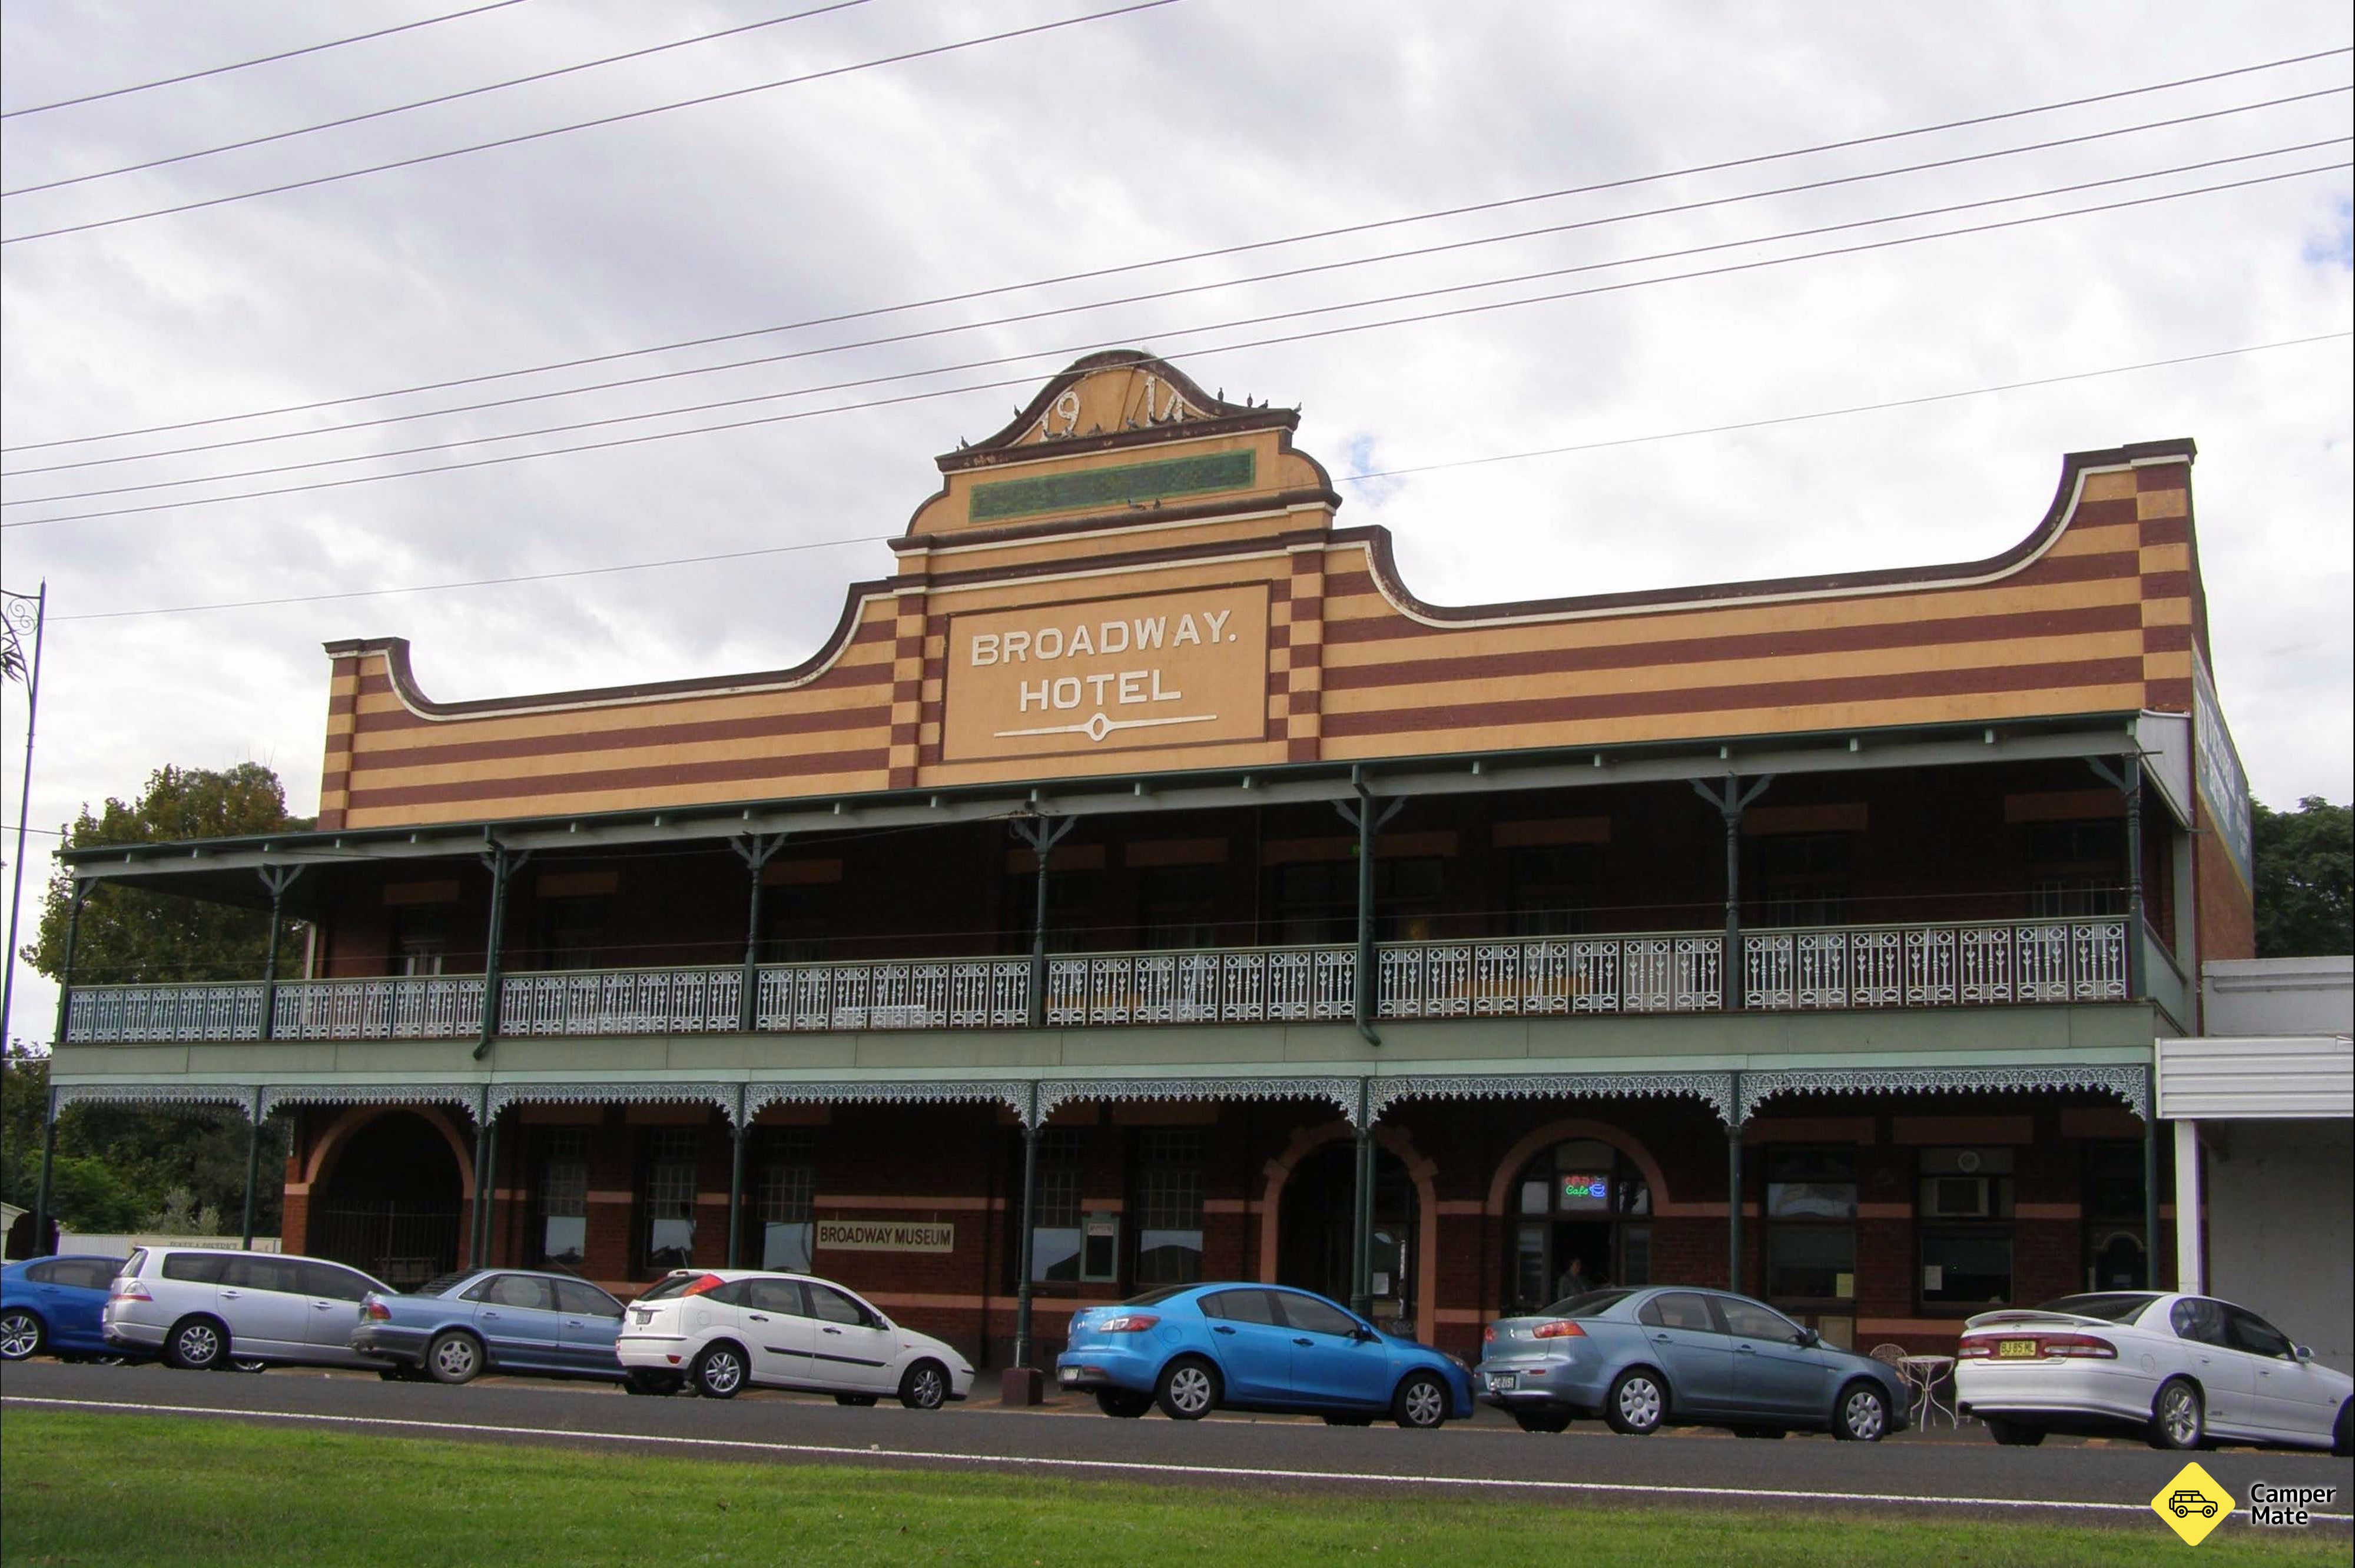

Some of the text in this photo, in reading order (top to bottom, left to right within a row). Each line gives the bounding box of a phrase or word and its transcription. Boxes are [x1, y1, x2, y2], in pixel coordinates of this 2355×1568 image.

[971, 610, 1238, 667] BROADWAY.
[1020, 669, 1182, 712] HOTEL
[820, 1226, 951, 1246] BROADWAY MUSEUM
